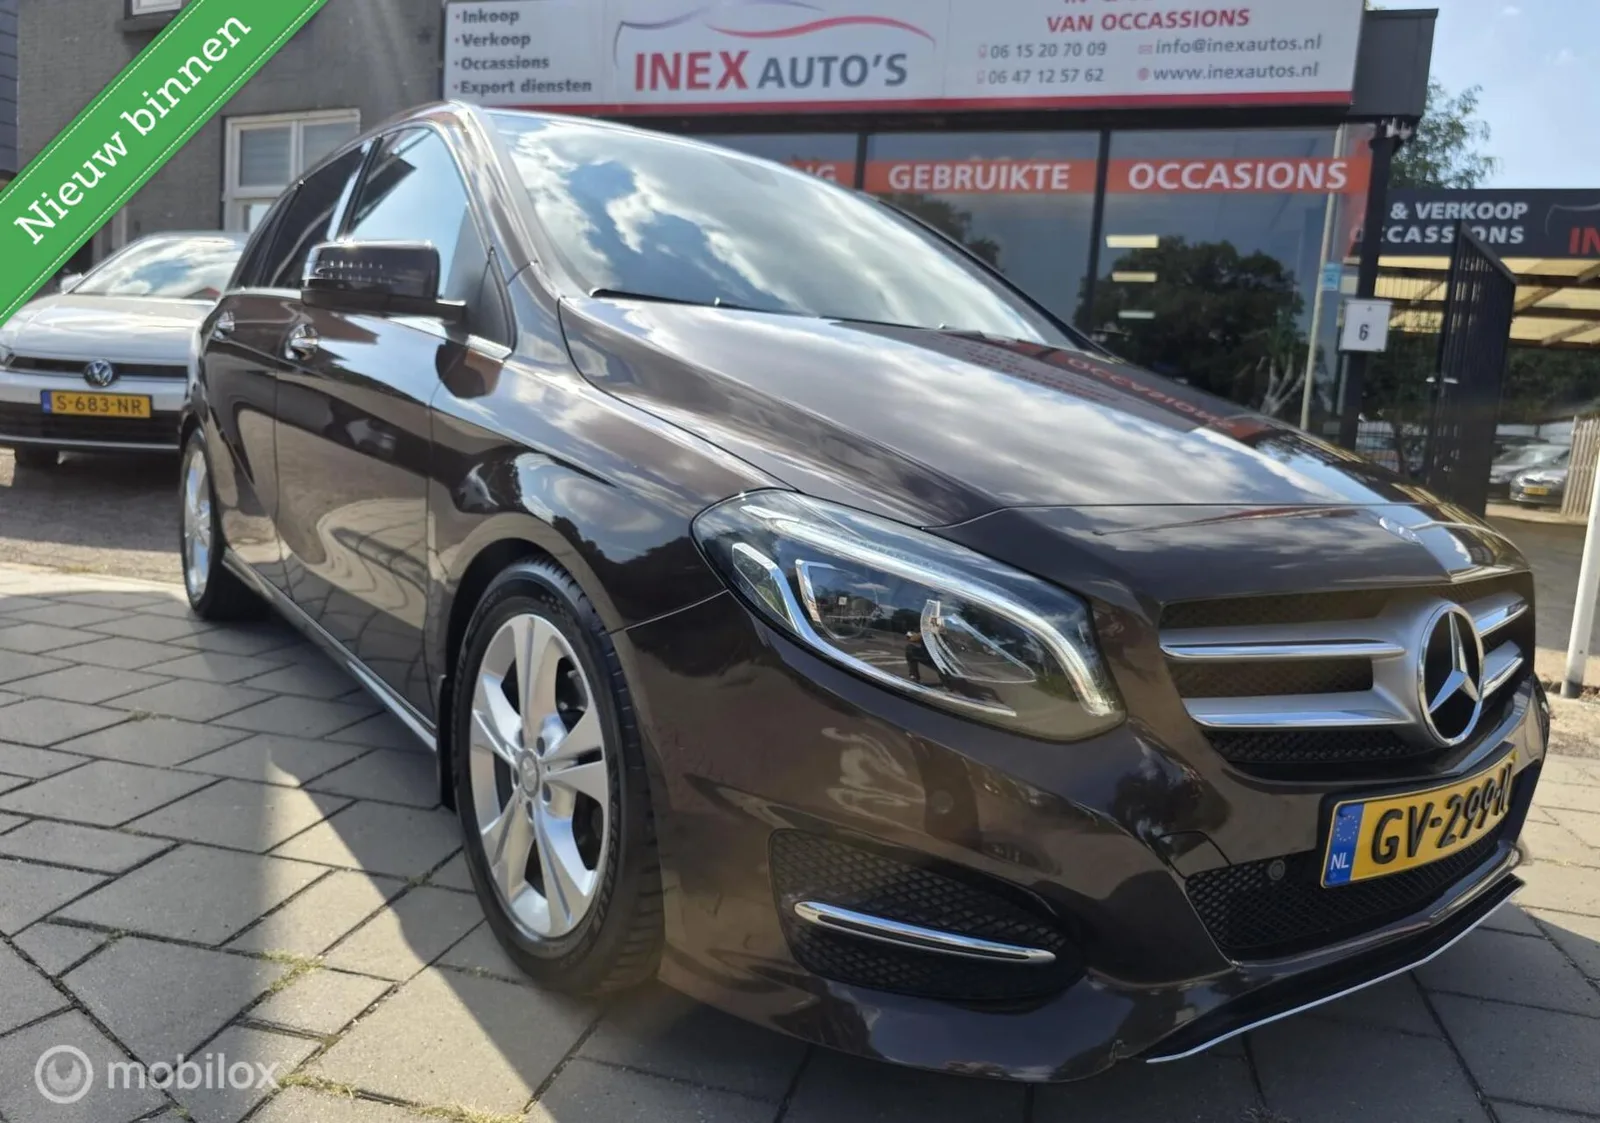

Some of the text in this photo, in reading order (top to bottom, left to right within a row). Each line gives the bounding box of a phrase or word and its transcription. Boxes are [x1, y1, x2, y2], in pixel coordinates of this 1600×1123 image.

[462, 8, 520, 25] Inkoop
[1047, 9, 1251, 33] VAN OCCASSIONS
[462, 32, 531, 48] Verkoop
[1155, 35, 1322, 55] info@inexautos.nl
[990, 41, 1107, 60] 06 15 20 70 09
[461, 56, 549, 71] Occassions
[634, 50, 908, 92] INEX AUTO'S
[1153, 62, 1320, 82] www.inexautos.nl
[988, 68, 1104, 85] 06 47 12 57 62
[460, 77, 592, 96] Export diensten
[888, 164, 1071, 191] GEBRUIKTE
[1128, 162, 1348, 190] OCCASIONS
[1390, 202, 1528, 220] & VERKOOP
[1359, 324, 1369, 341] 6
[56, 395, 144, 415] S-683-NR
[1330, 852, 1349, 871] NL
